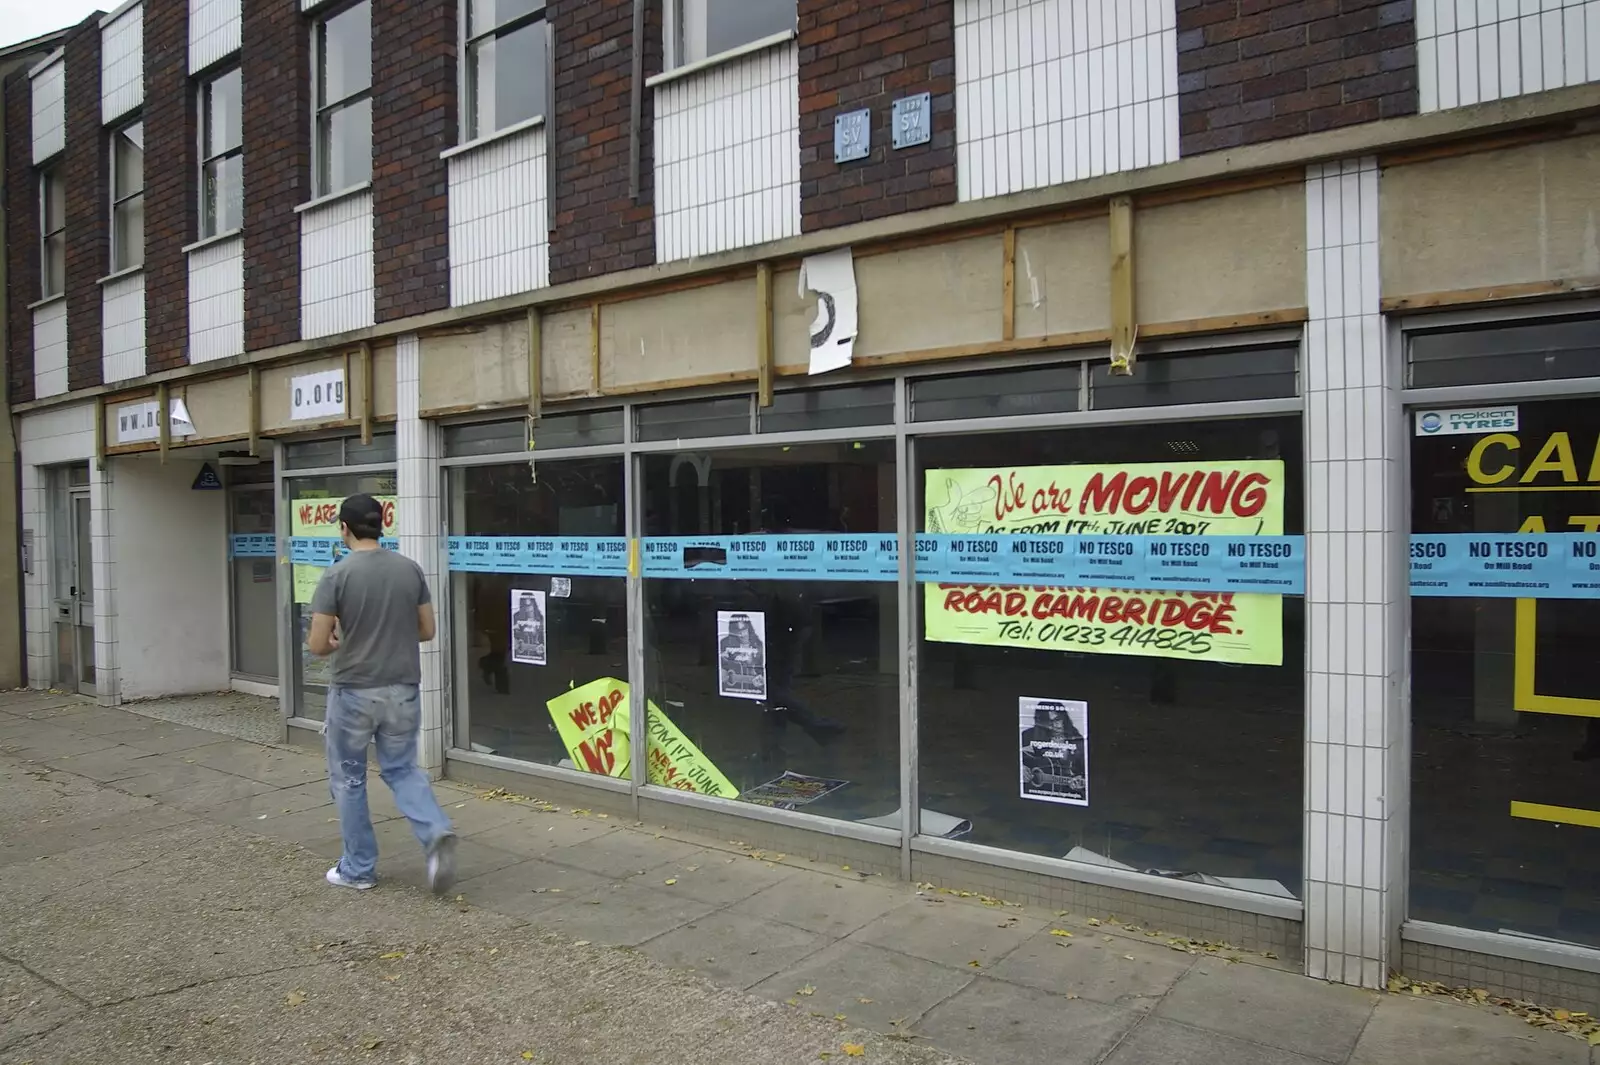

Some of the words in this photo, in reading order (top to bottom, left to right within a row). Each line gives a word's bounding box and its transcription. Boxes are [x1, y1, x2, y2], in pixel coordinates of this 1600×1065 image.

[901, 112, 921, 132] SV
[842, 126, 861, 145] SV
[295, 381, 343, 407] o.org
[1450, 419, 1515, 429] TYRES
[987, 471, 1027, 521] We
[1032, 480, 1073, 515] are
[1079, 470, 1271, 517] MOVING
[299, 504, 313, 526] WE
[1104, 518, 1161, 535] JUNE
[1165, 518, 1211, 535] 2007
[496, 541, 502, 550] NO
[504, 541, 520, 550] TESCO
[528, 541, 535, 550] NO
[536, 542, 553, 551] TESCO
[561, 542, 569, 551] NO
[570, 542, 589, 552] TESCO
[597, 542, 605, 552] NO
[606, 542, 626, 552] TESCO
[646, 542, 655, 552] NO
[655, 542, 677, 552] TESCO
[730, 541, 740, 551] NO
[742, 541, 766, 552] TESCO
[777, 540, 788, 551] NO
[789, 540, 815, 552] TESCO
[827, 540, 838, 551] NO
[840, 540, 867, 551] TESCO
[880, 540, 892, 551] NO
[951, 541, 964, 552] NO
[967, 541, 998, 552] TESCO
[1012, 541, 1026, 553] NO
[1030, 541, 1063, 553] TESCO
[1080, 541, 1094, 554] NO
[1097, 542, 1133, 555] TESCO
[1151, 542, 1167, 555] NO
[1170, 543, 1210, 556] TESCO
[1228, 543, 1245, 557] NO
[1249, 543, 1291, 557] TESCO
[1410, 542, 1447, 557] ESCO
[1469, 542, 1491, 557] NO
[1495, 542, 1548, 557] TESCO
[1573, 541, 1596, 557] NO
[1484, 562, 1494, 570] On
[1496, 562, 1511, 570] Mill
[1512, 562, 1532, 570] Road
[944, 590, 1027, 619] ROAD.
[1031, 591, 1243, 635] CAMBRIDGE.
[999, 621, 1034, 640] Tel:
[1037, 623, 1105, 645] 01233
[1109, 626, 1212, 653] 414825
[568, 702, 597, 731] WE
[598, 689, 625, 724] AR
[648, 710, 678, 747] ROM
[688, 765, 722, 796] JUNE
